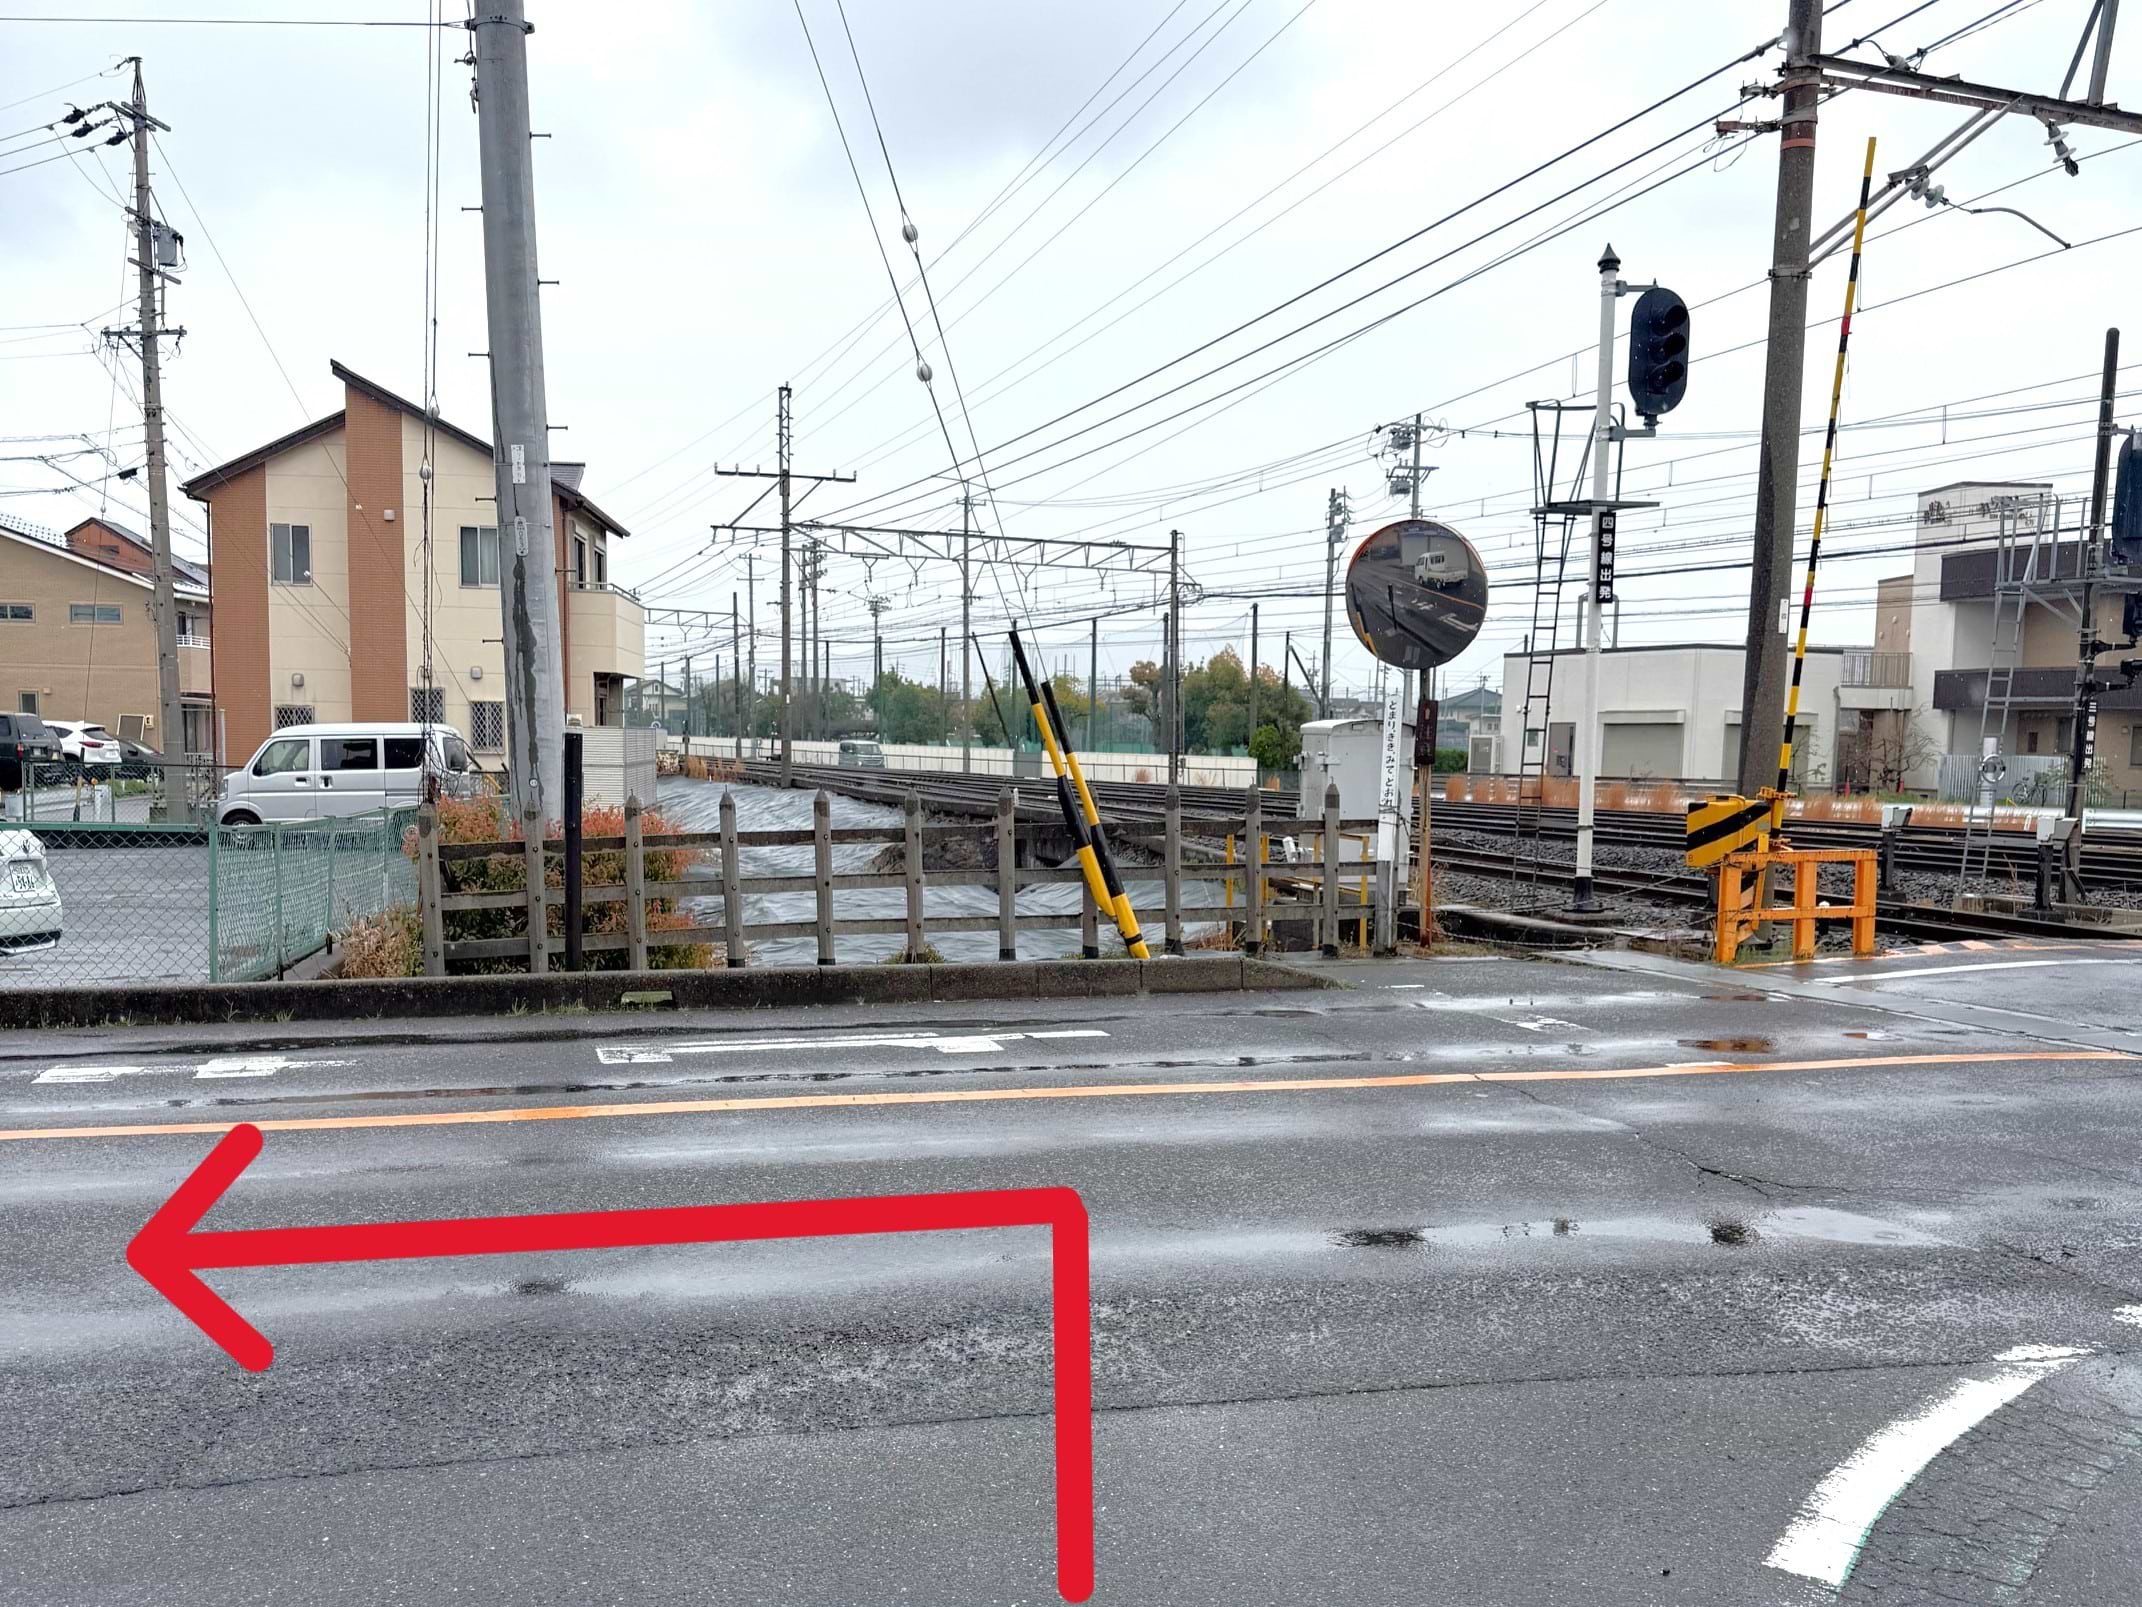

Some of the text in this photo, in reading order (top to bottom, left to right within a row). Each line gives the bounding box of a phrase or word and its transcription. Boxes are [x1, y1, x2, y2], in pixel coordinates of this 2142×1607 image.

[1599, 516, 1614, 600] 四号線出発
